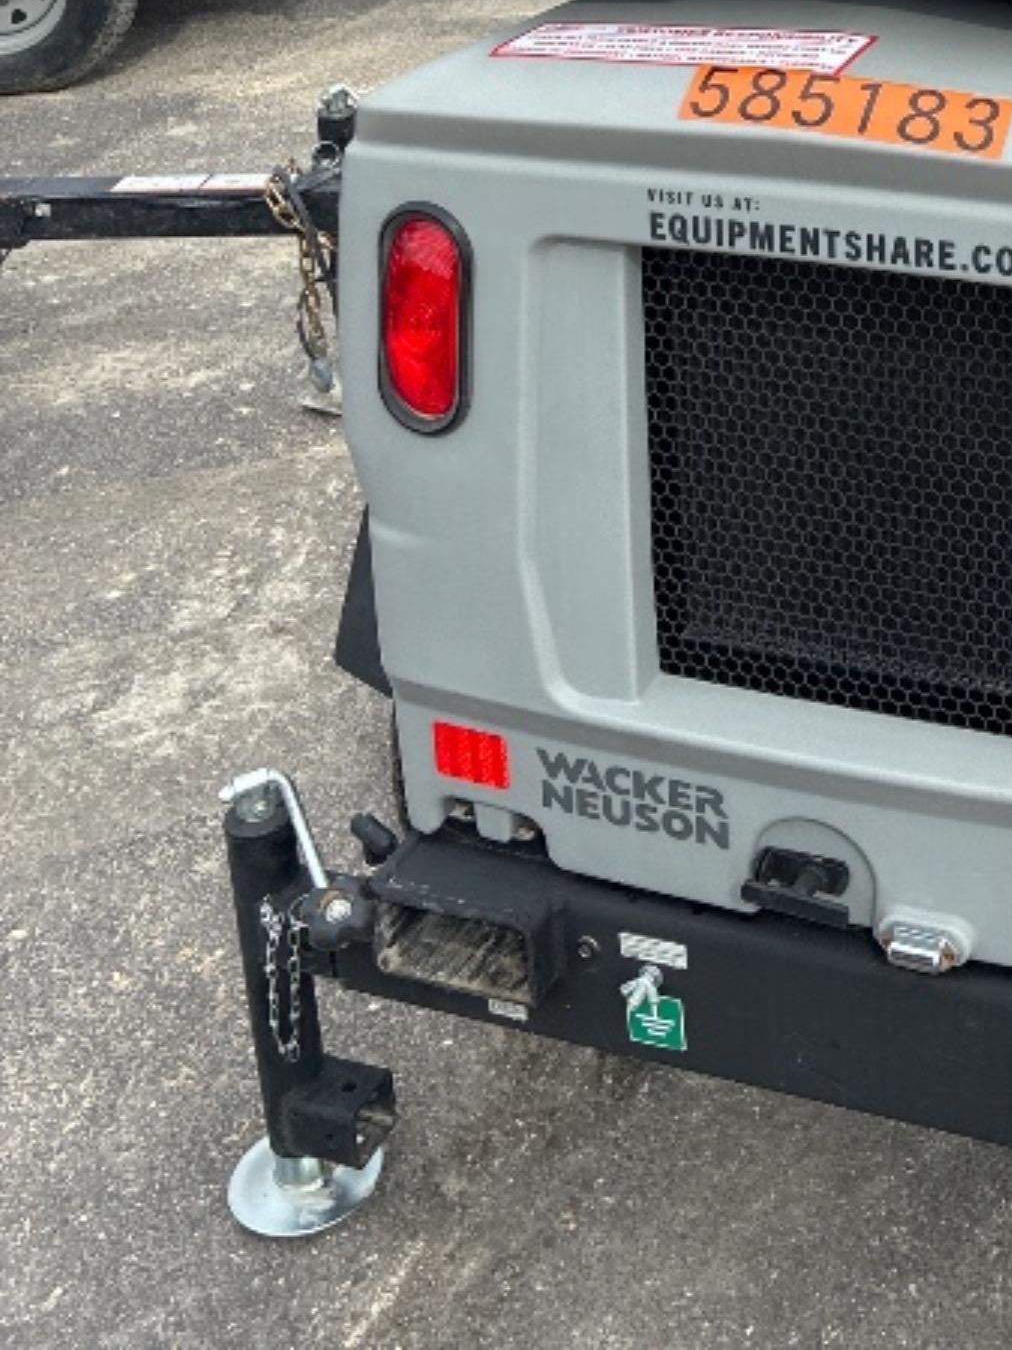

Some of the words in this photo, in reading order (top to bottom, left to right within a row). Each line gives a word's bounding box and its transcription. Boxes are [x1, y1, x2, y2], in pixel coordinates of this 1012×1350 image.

[689, 66, 1000, 152] 585183
[647, 188, 695, 206] VISIT
[701, 193, 725, 210] US
[731, 197, 760, 214] AT:
[536, 746, 729, 819] WACKER
[542, 779, 730, 850] NEUSON
